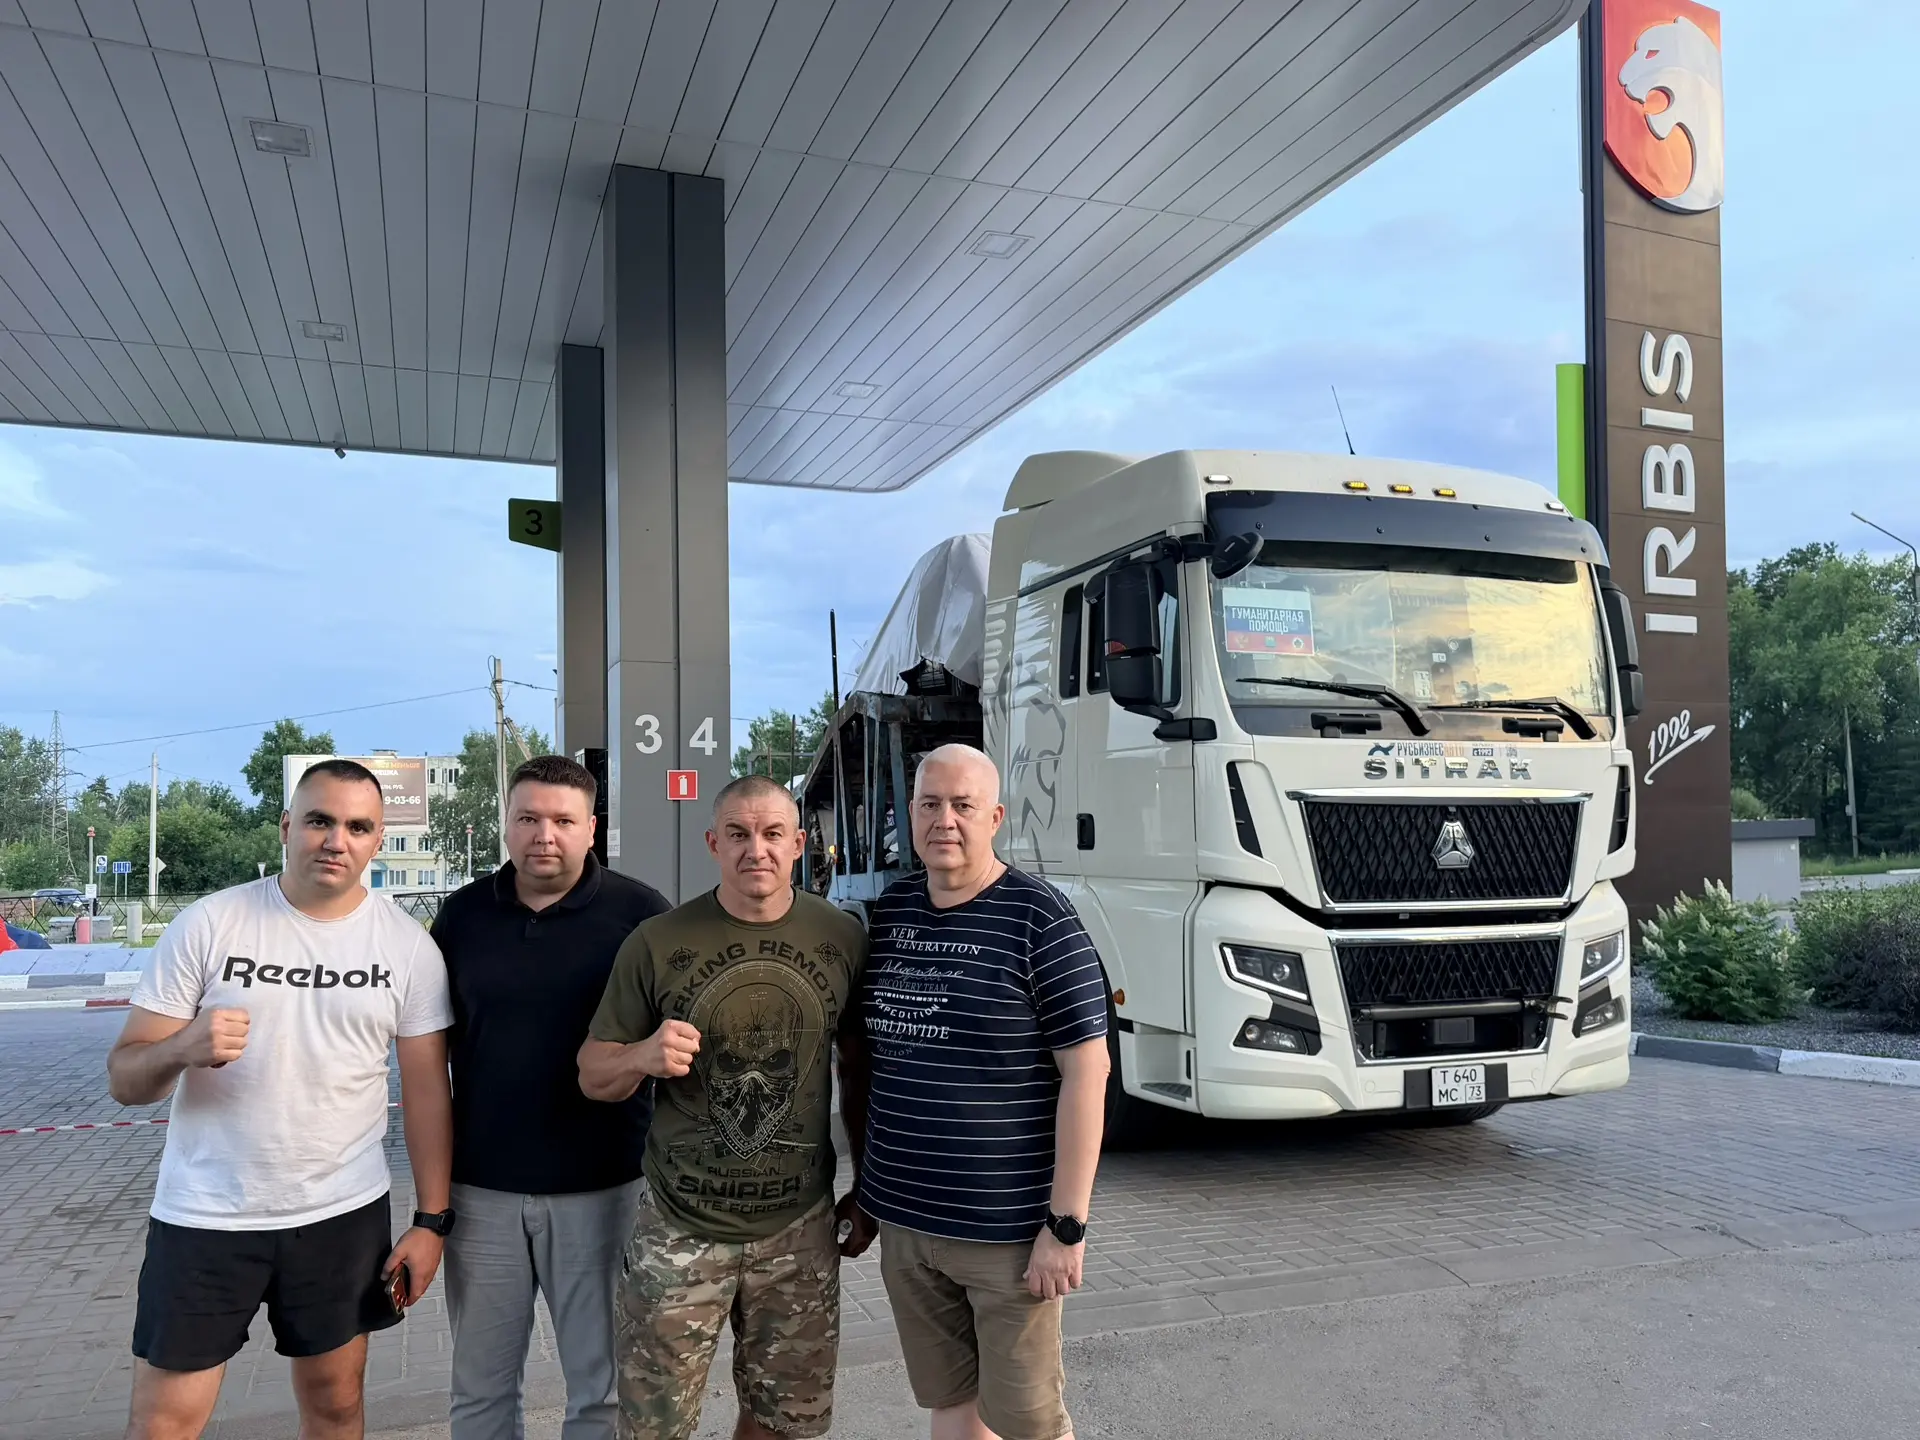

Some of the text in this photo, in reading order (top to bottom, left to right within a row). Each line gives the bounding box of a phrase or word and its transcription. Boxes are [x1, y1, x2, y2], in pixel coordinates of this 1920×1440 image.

[1639, 330, 1698, 635] IRBIS
[524, 508, 544, 536] 3
[1231, 606, 1305, 623] ГУМАНИТАРНАЯ
[1248, 619, 1289, 635] ПОМОЩЬ
[634, 713, 718, 756] 3 4
[1647, 709, 1692, 766] 1998
[1363, 757, 1532, 780] SITRAK
[889, 927, 919, 939] NEW
[895, 940, 981, 955] GENERATION
[222, 955, 392, 990] Reebok
[924, 982, 948, 993] TEAM
[875, 998, 940, 1019] EXPEDITION
[865, 1016, 950, 1040] WORLDWIDE
[1453, 1068, 1477, 1083] 640
[1469, 1086, 1481, 1097] 73
[675, 1174, 800, 1200] SNIPER
[686, 1198, 722, 1212] LITE
